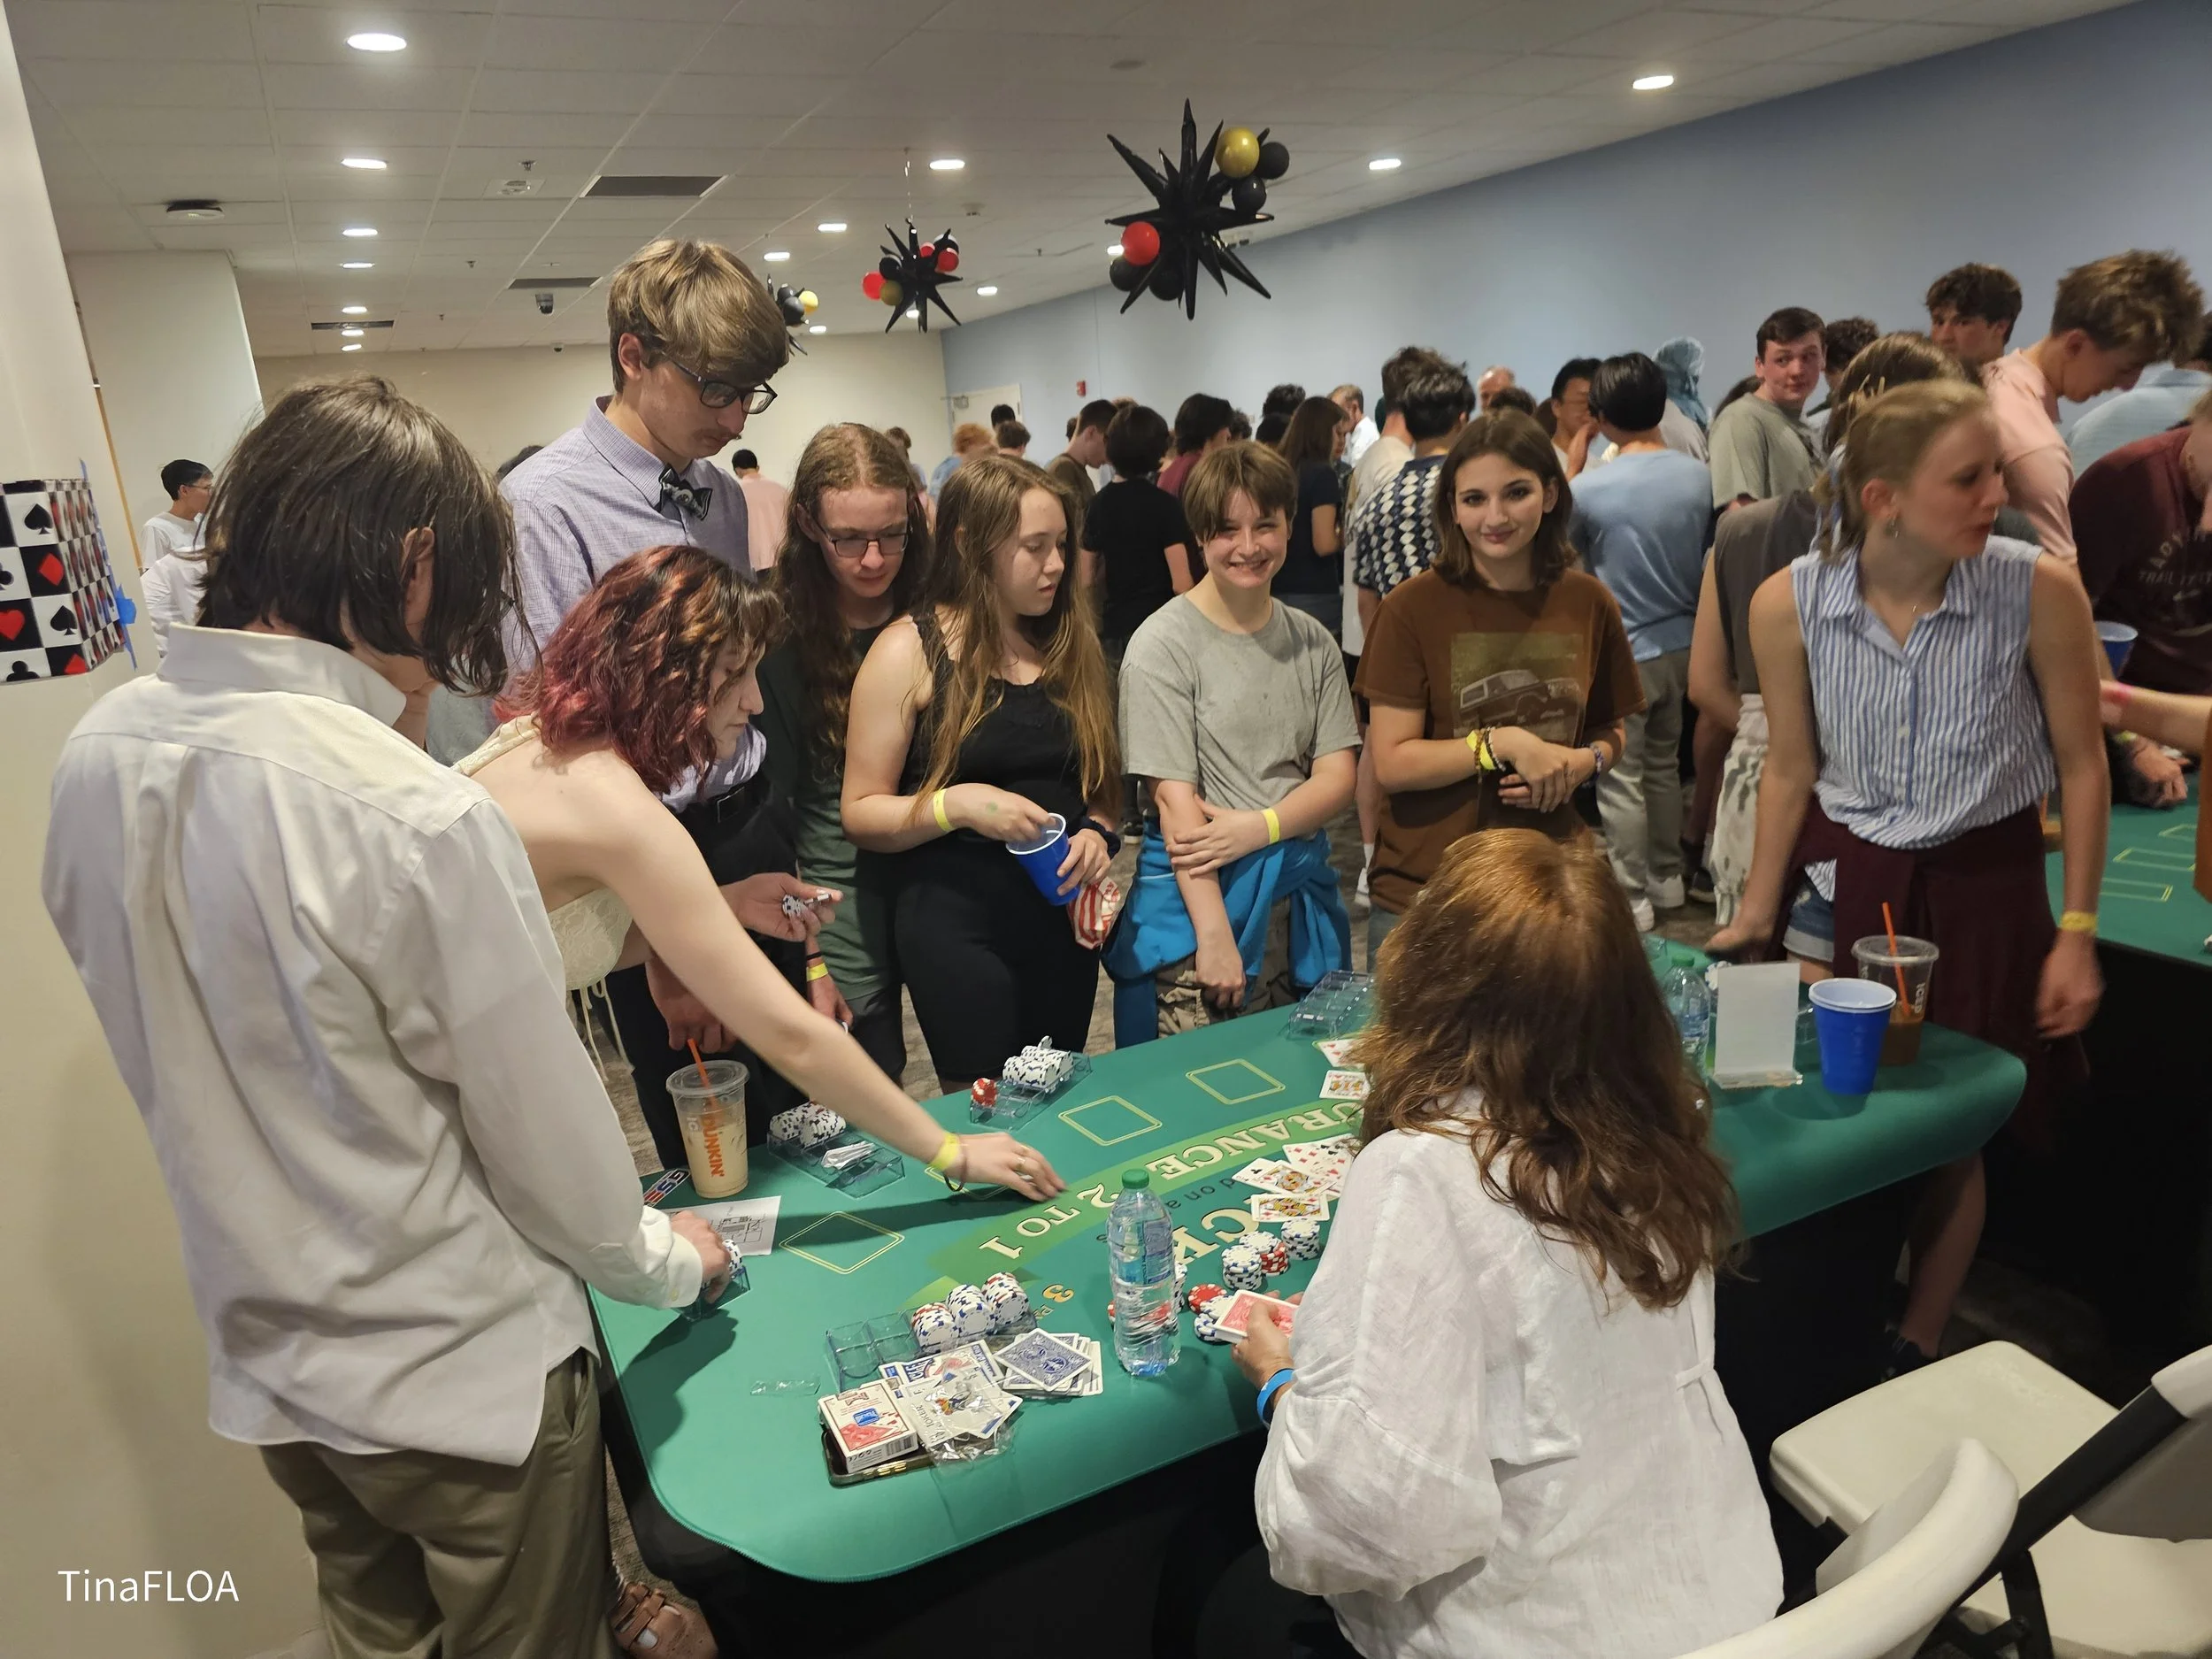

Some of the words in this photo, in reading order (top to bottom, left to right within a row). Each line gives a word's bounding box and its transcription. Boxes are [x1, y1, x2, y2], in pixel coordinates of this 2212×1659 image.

[1915, 982, 1926, 1014] ICED
[1145, 1102, 1363, 1180] URANCE
[1076, 1182, 1119, 1209] 2
[1183, 1186, 1216, 1202] on
[1016, 1204, 1081, 1237] TO
[979, 1235, 1024, 1260] 1
[1042, 1283, 1074, 1303] 3
[916, 1404, 934, 1428] JOKER
